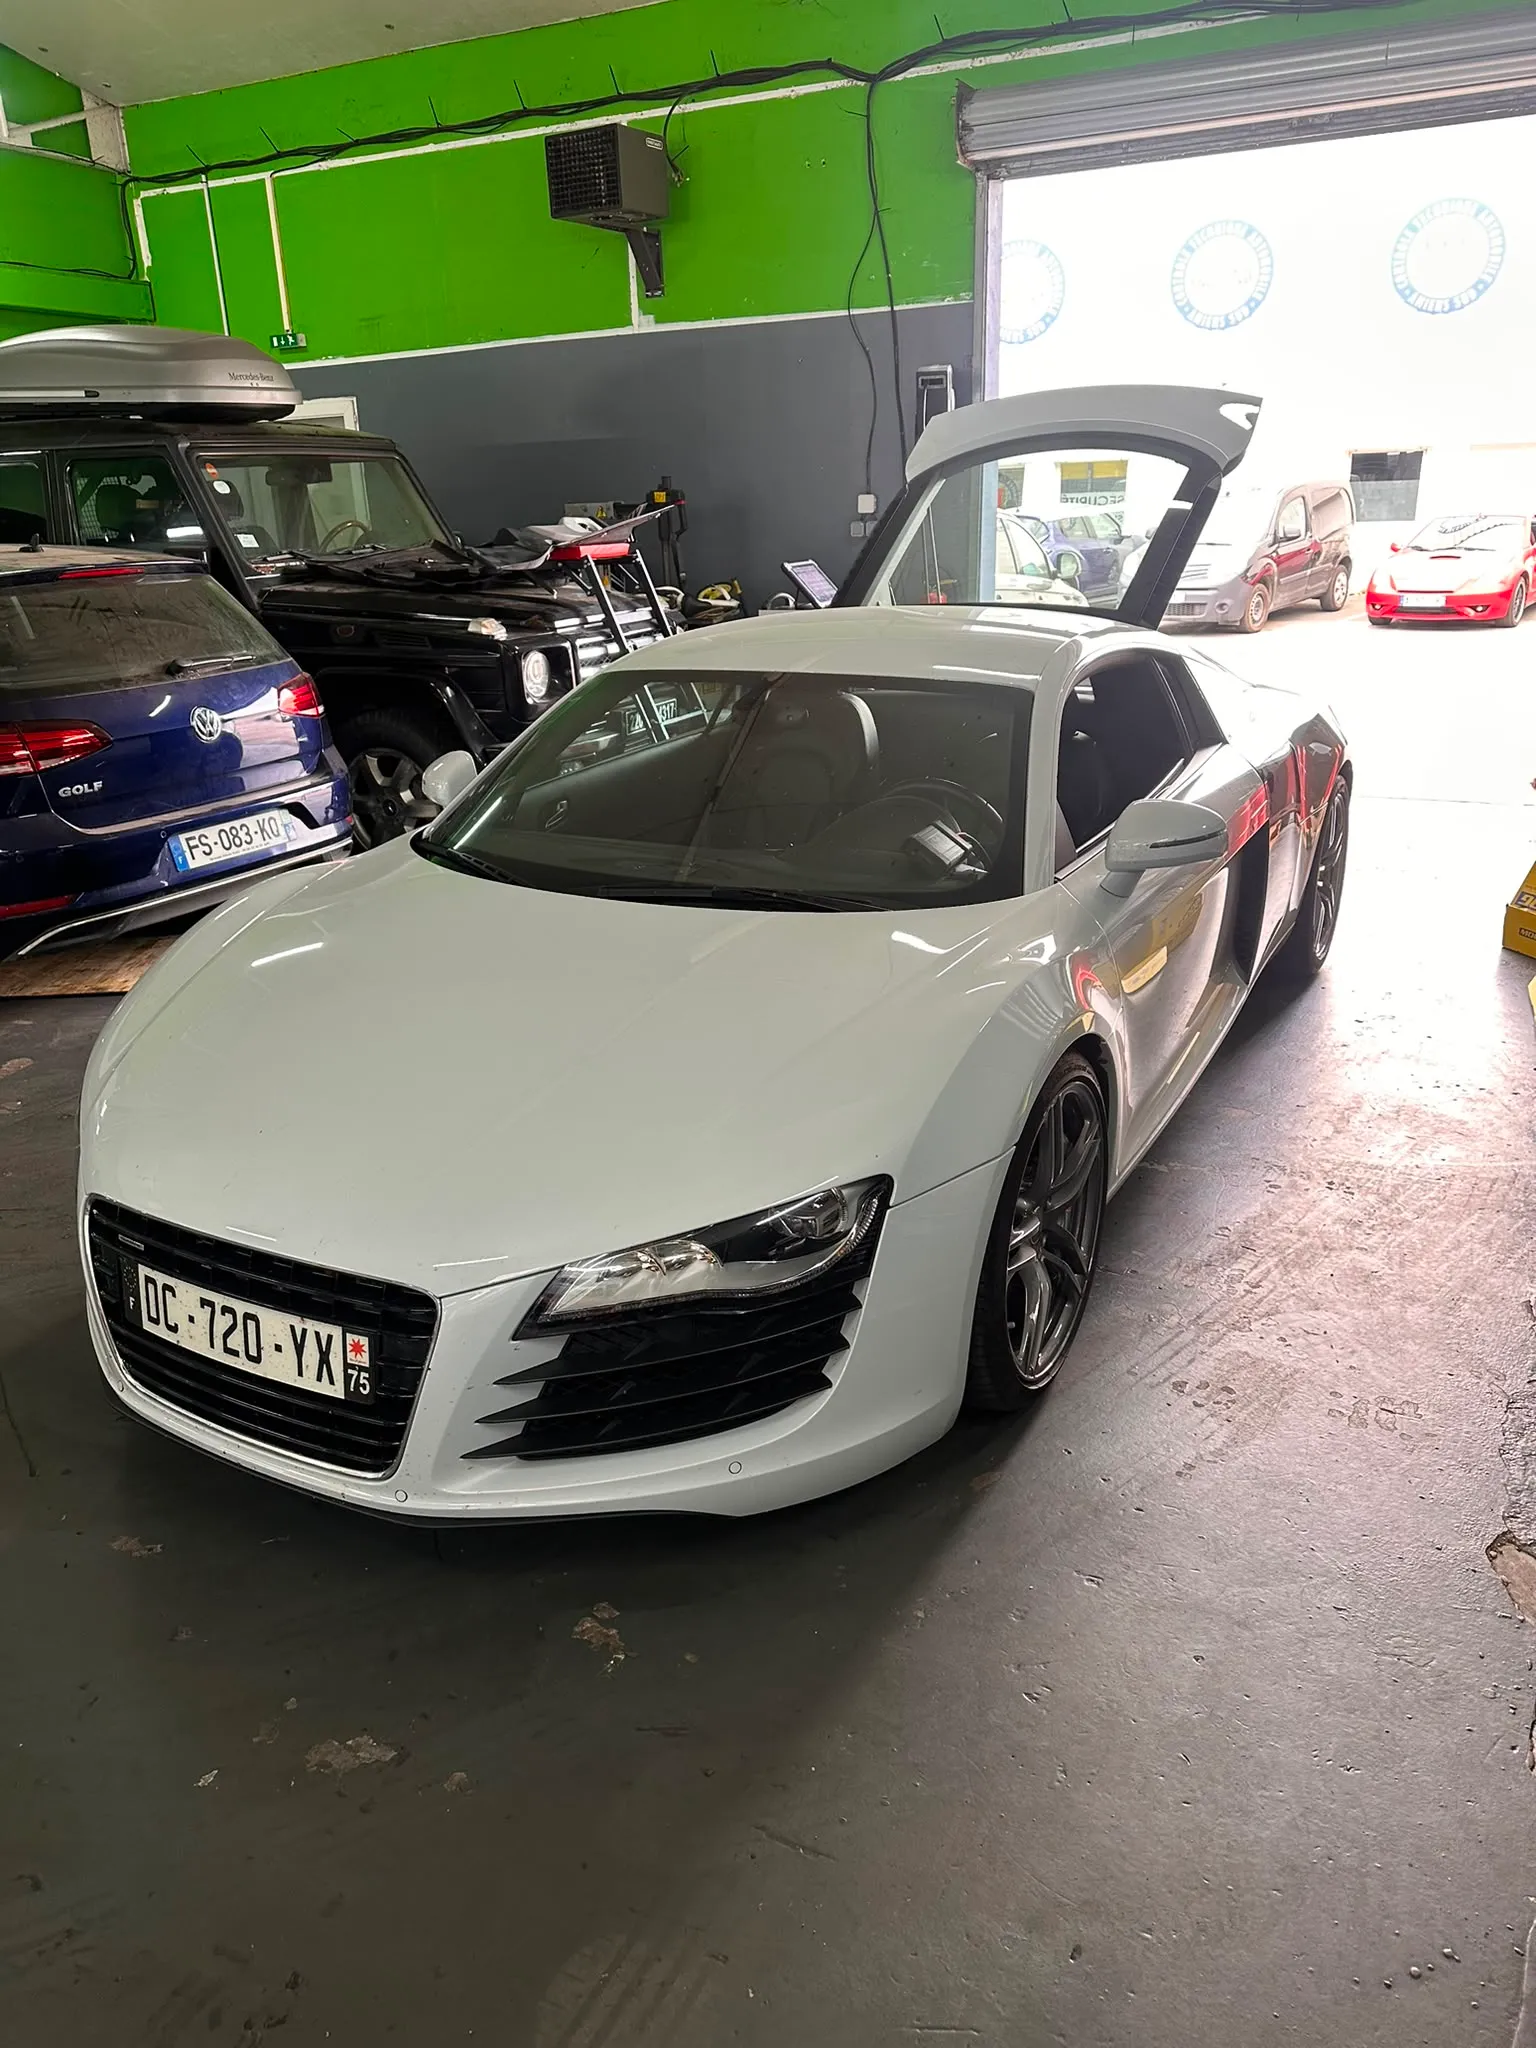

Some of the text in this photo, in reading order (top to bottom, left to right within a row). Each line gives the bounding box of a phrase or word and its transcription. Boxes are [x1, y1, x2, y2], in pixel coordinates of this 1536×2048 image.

[58, 780, 103, 798] GOLF
[129, 1296, 136, 1311] F
[347, 1368, 370, 1395] 75
